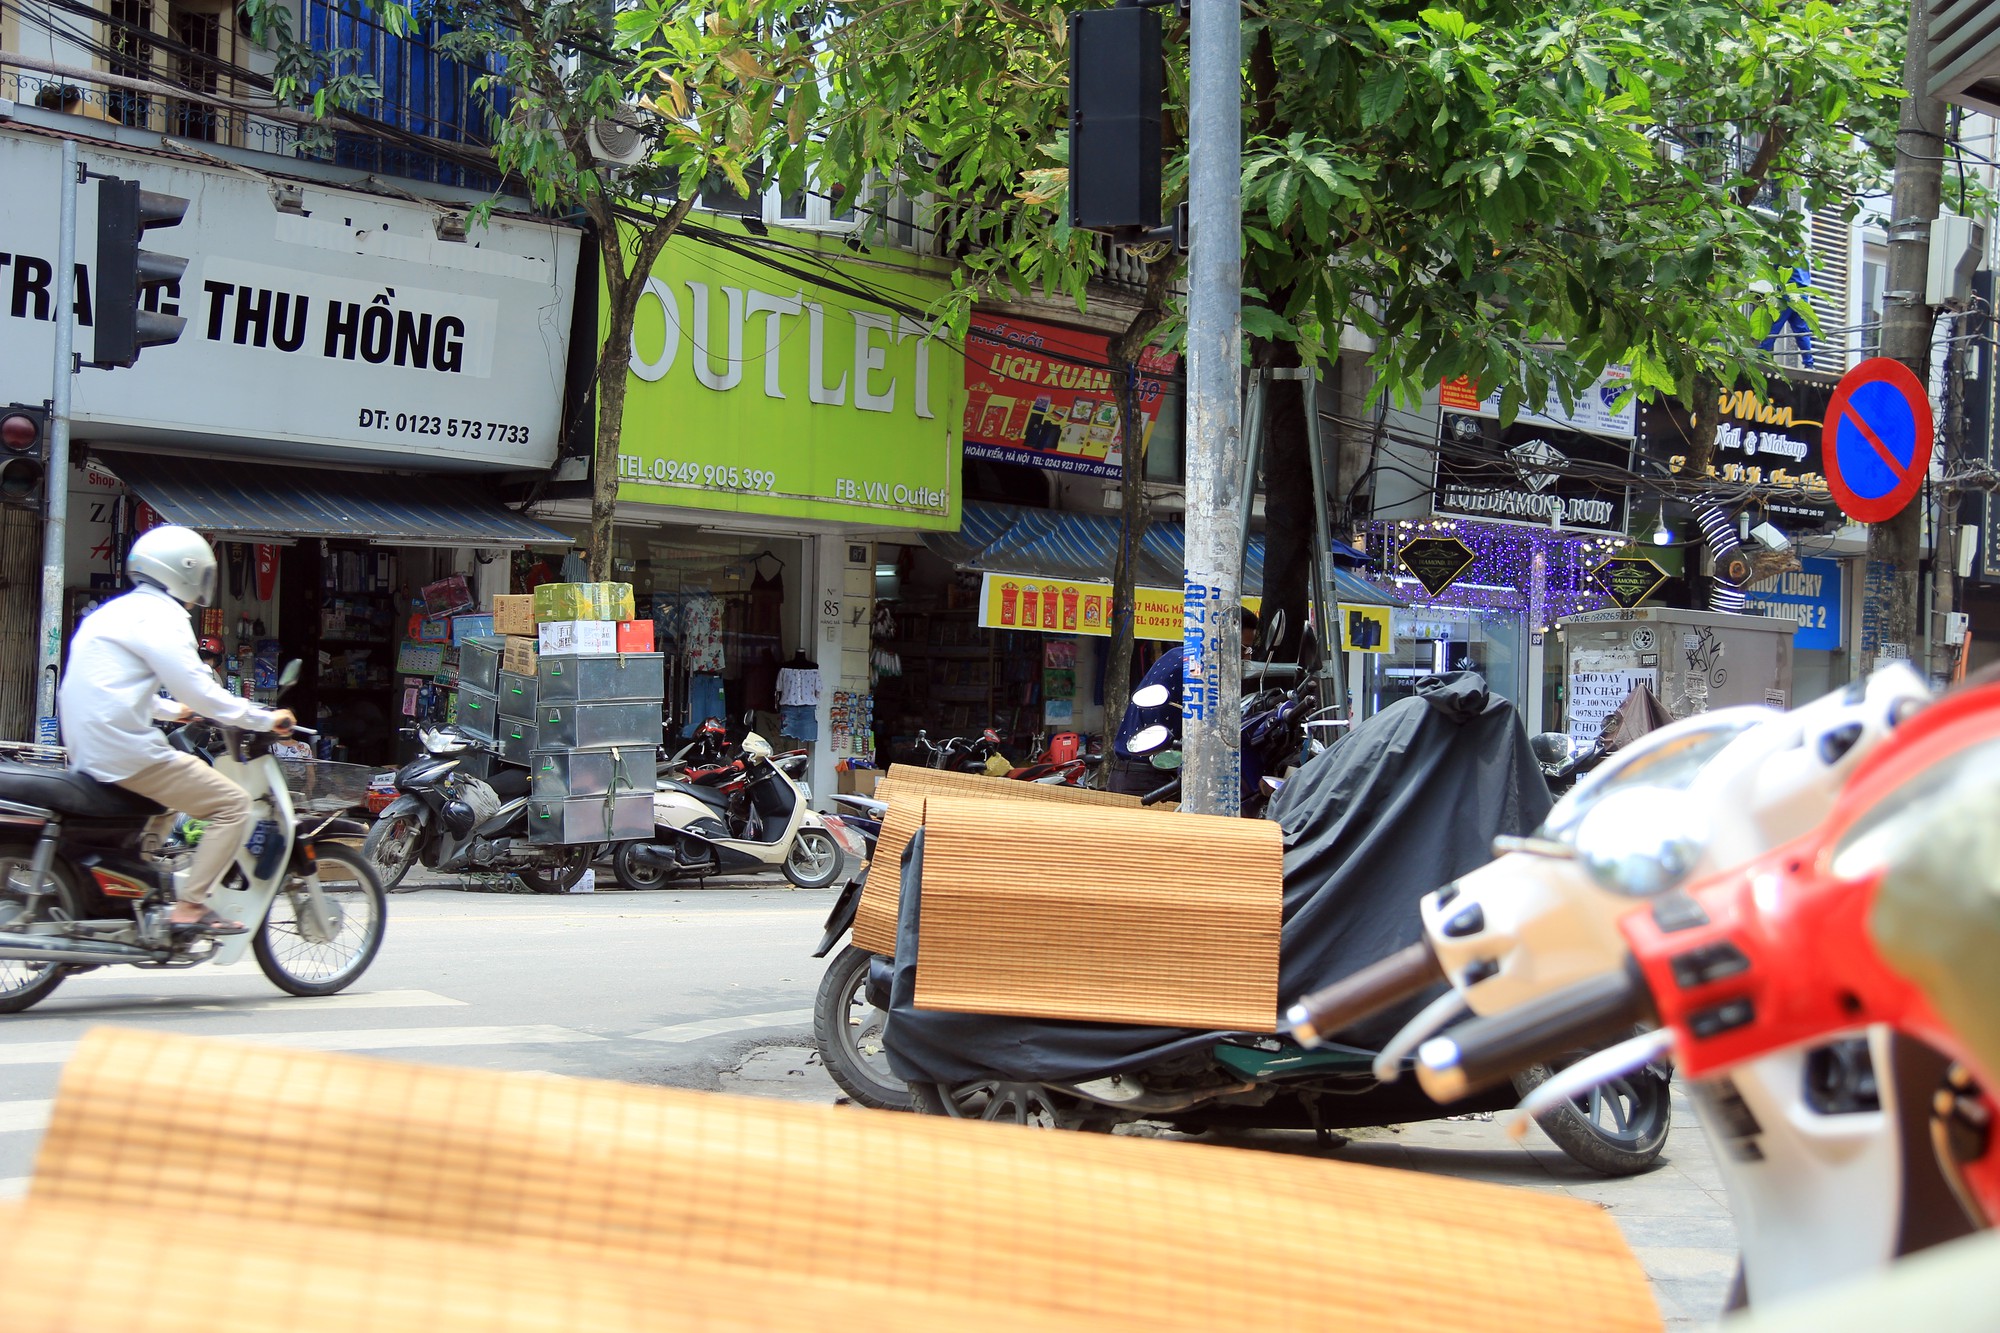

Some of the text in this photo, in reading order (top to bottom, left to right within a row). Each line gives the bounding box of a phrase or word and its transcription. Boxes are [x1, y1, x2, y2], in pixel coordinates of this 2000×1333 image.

[0, 252, 465, 373] RAG THU HỒNG
[628, 275, 949, 419] OUTLET
[988, 352, 1042, 383] LỊCH
[358, 408, 530, 444] ĐT: 0123 573 7733
[1713, 422, 1808, 462] Nail & Makeup
[964, 445, 986, 457] HOÀN
[1005, 451, 1016, 461] HÀ
[1016, 454, 1030, 466] NỘI
[1032, 458, 1045, 466] TEL:
[1045, 458, 1061, 468] 0243
[1062, 460, 1074, 470] 923
[1074, 462, 1090, 472] 1977
[1093, 466, 1105, 475] 091
[1105, 468, 1118, 477] 664
[89, 473, 115, 489] Shop
[704, 464, 739, 487] 905
[741, 468, 775, 491] 399
[893, 483, 946, 508] Outlet
[852, 549, 864, 560] 87
[1782, 571, 1822, 598] LUCKY
[824, 600, 839, 617] 85
[1144, 601, 1170, 613] HÀNG
[1817, 605, 1827, 629] 2
[1149, 617, 1170, 627] 0243
[1172, 618, 1184, 628] 92
[1575, 673, 1598, 683] CHO
[1575, 684, 1591, 695] TÍN
[1587, 699, 1599, 707] 100
[1574, 722, 1597, 732] CHO
